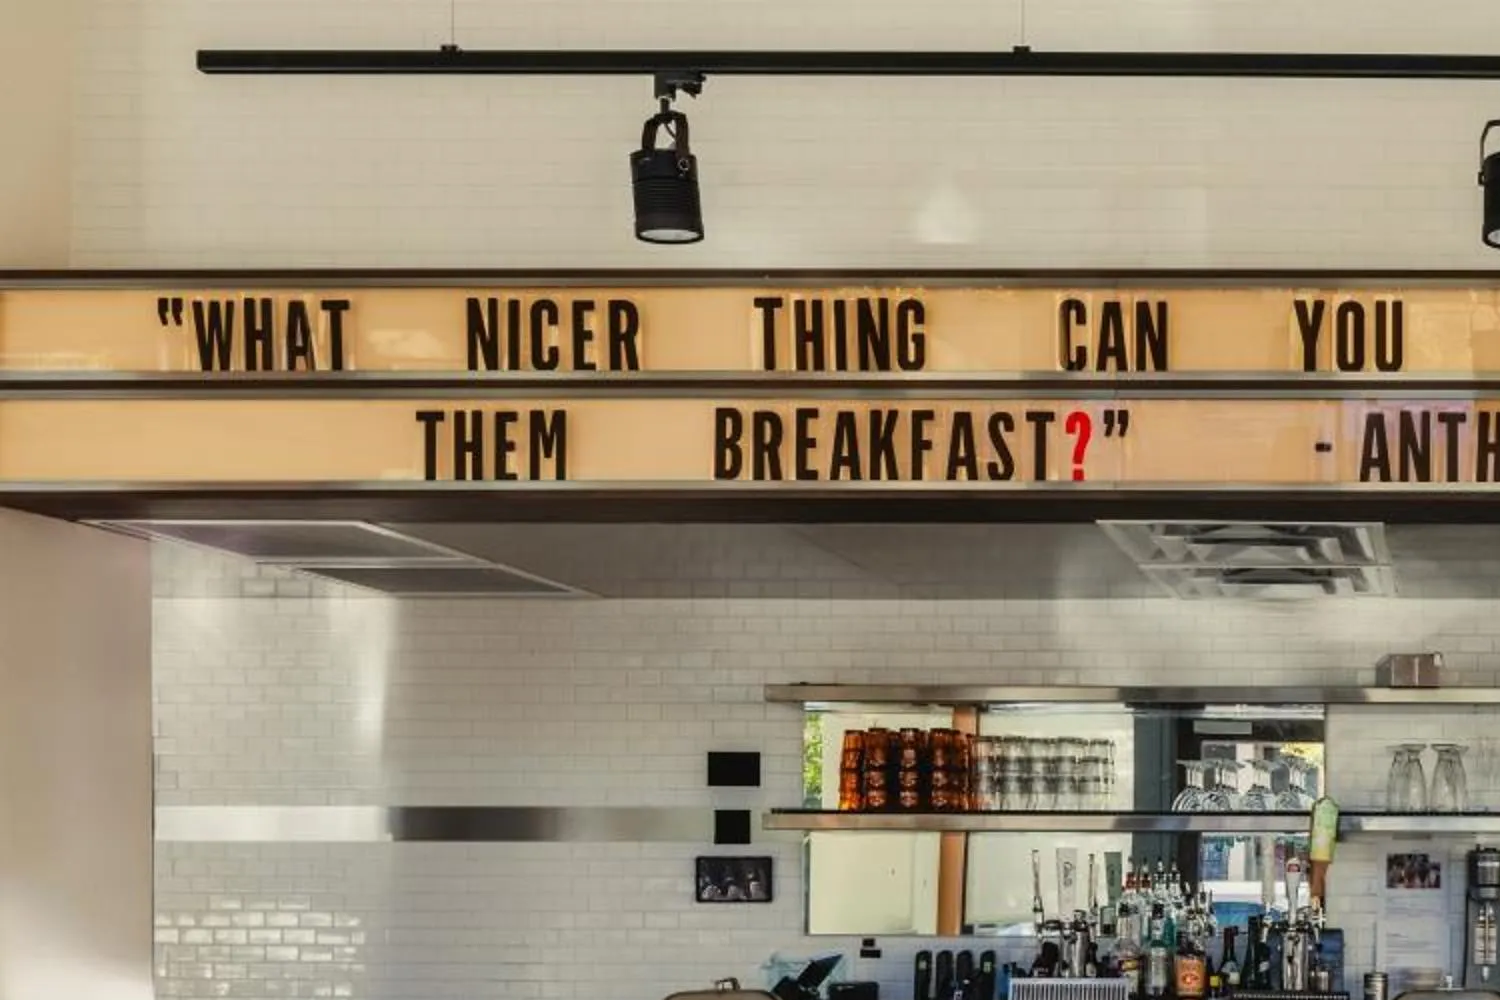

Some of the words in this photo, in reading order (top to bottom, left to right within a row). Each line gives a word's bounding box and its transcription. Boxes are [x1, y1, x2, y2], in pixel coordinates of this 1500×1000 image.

[157, 297, 351, 371] "WHAT
[466, 298, 640, 371] NICER
[753, 297, 926, 371] THING
[1060, 299, 1169, 372] CAN
[1293, 300, 1403, 372] YOU
[415, 409, 567, 481] THEM
